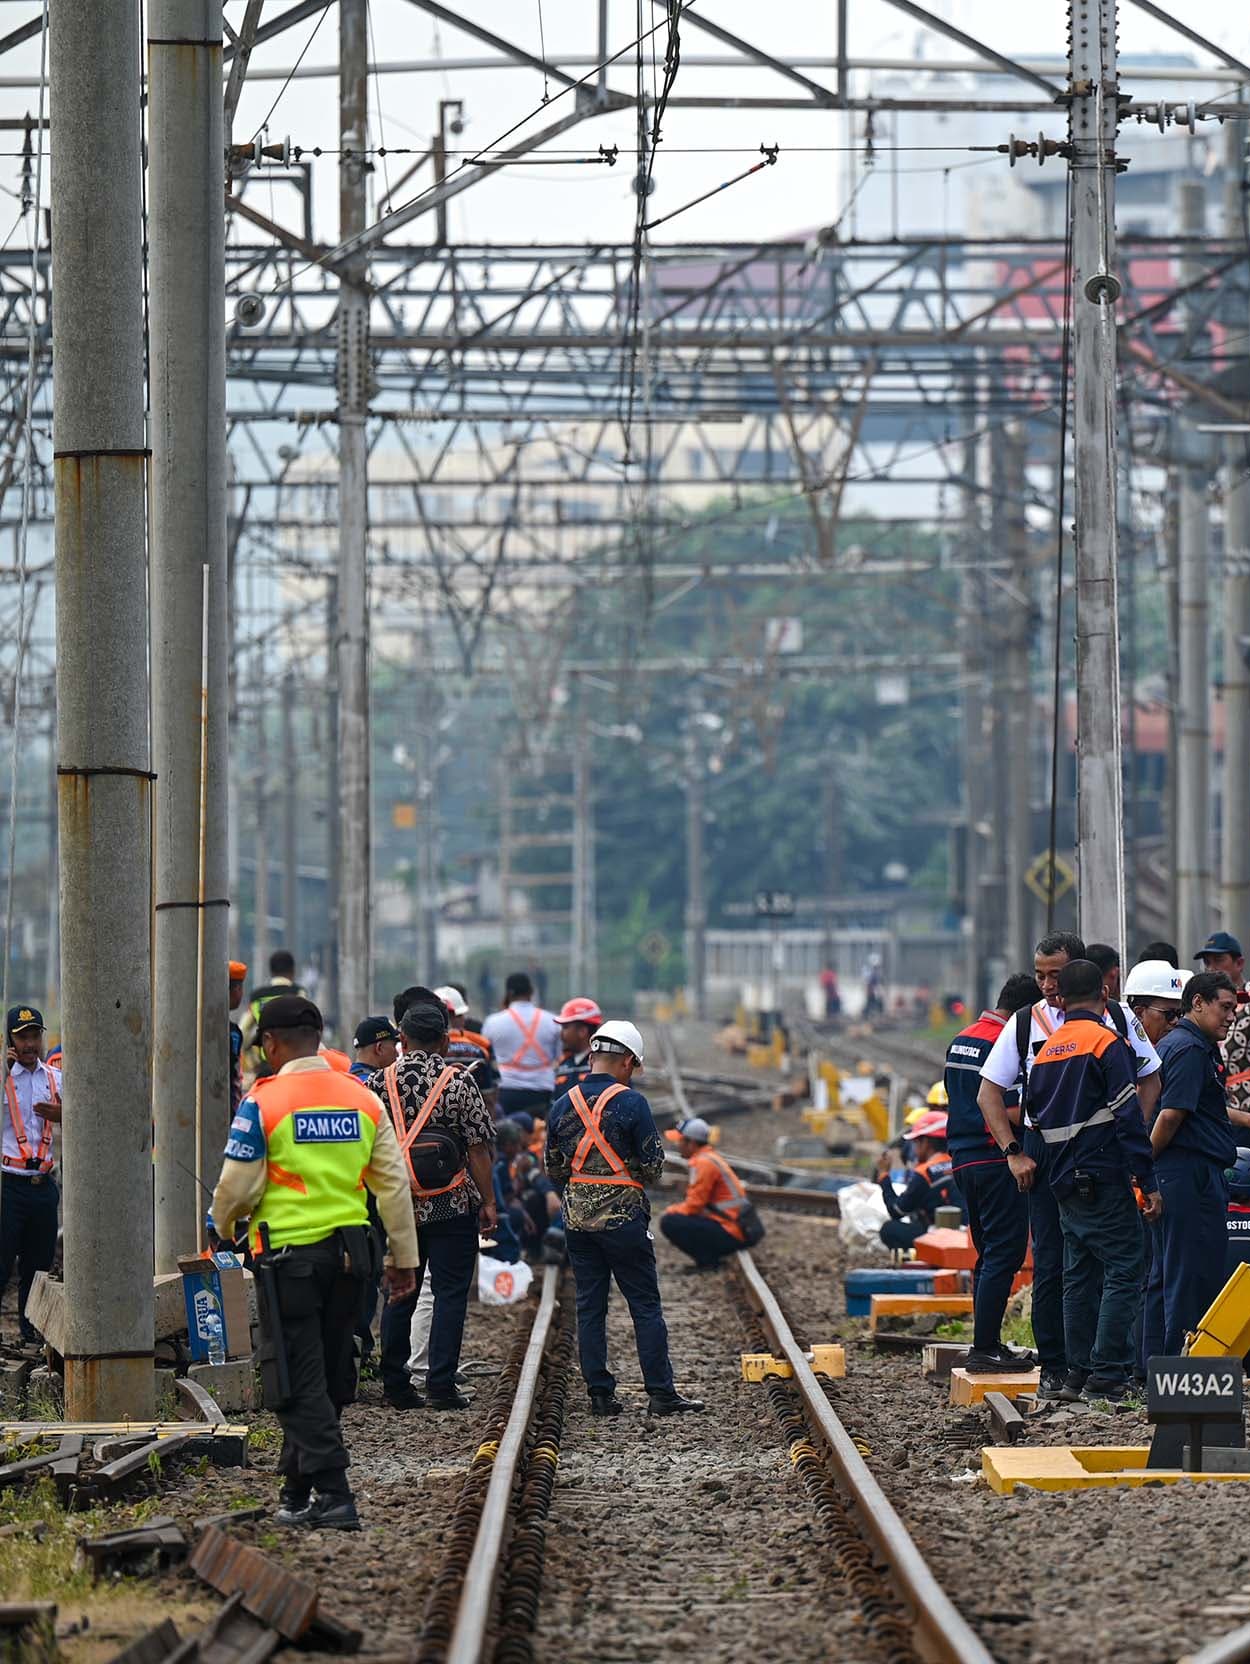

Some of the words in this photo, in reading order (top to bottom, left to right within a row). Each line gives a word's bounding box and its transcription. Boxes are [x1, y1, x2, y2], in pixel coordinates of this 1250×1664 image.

[1045, 1042, 1078, 1057] OPERASI
[296, 1117, 330, 1137] PAM
[331, 1116, 358, 1136] KCI
[1155, 1372, 1235, 1397] W43A2
